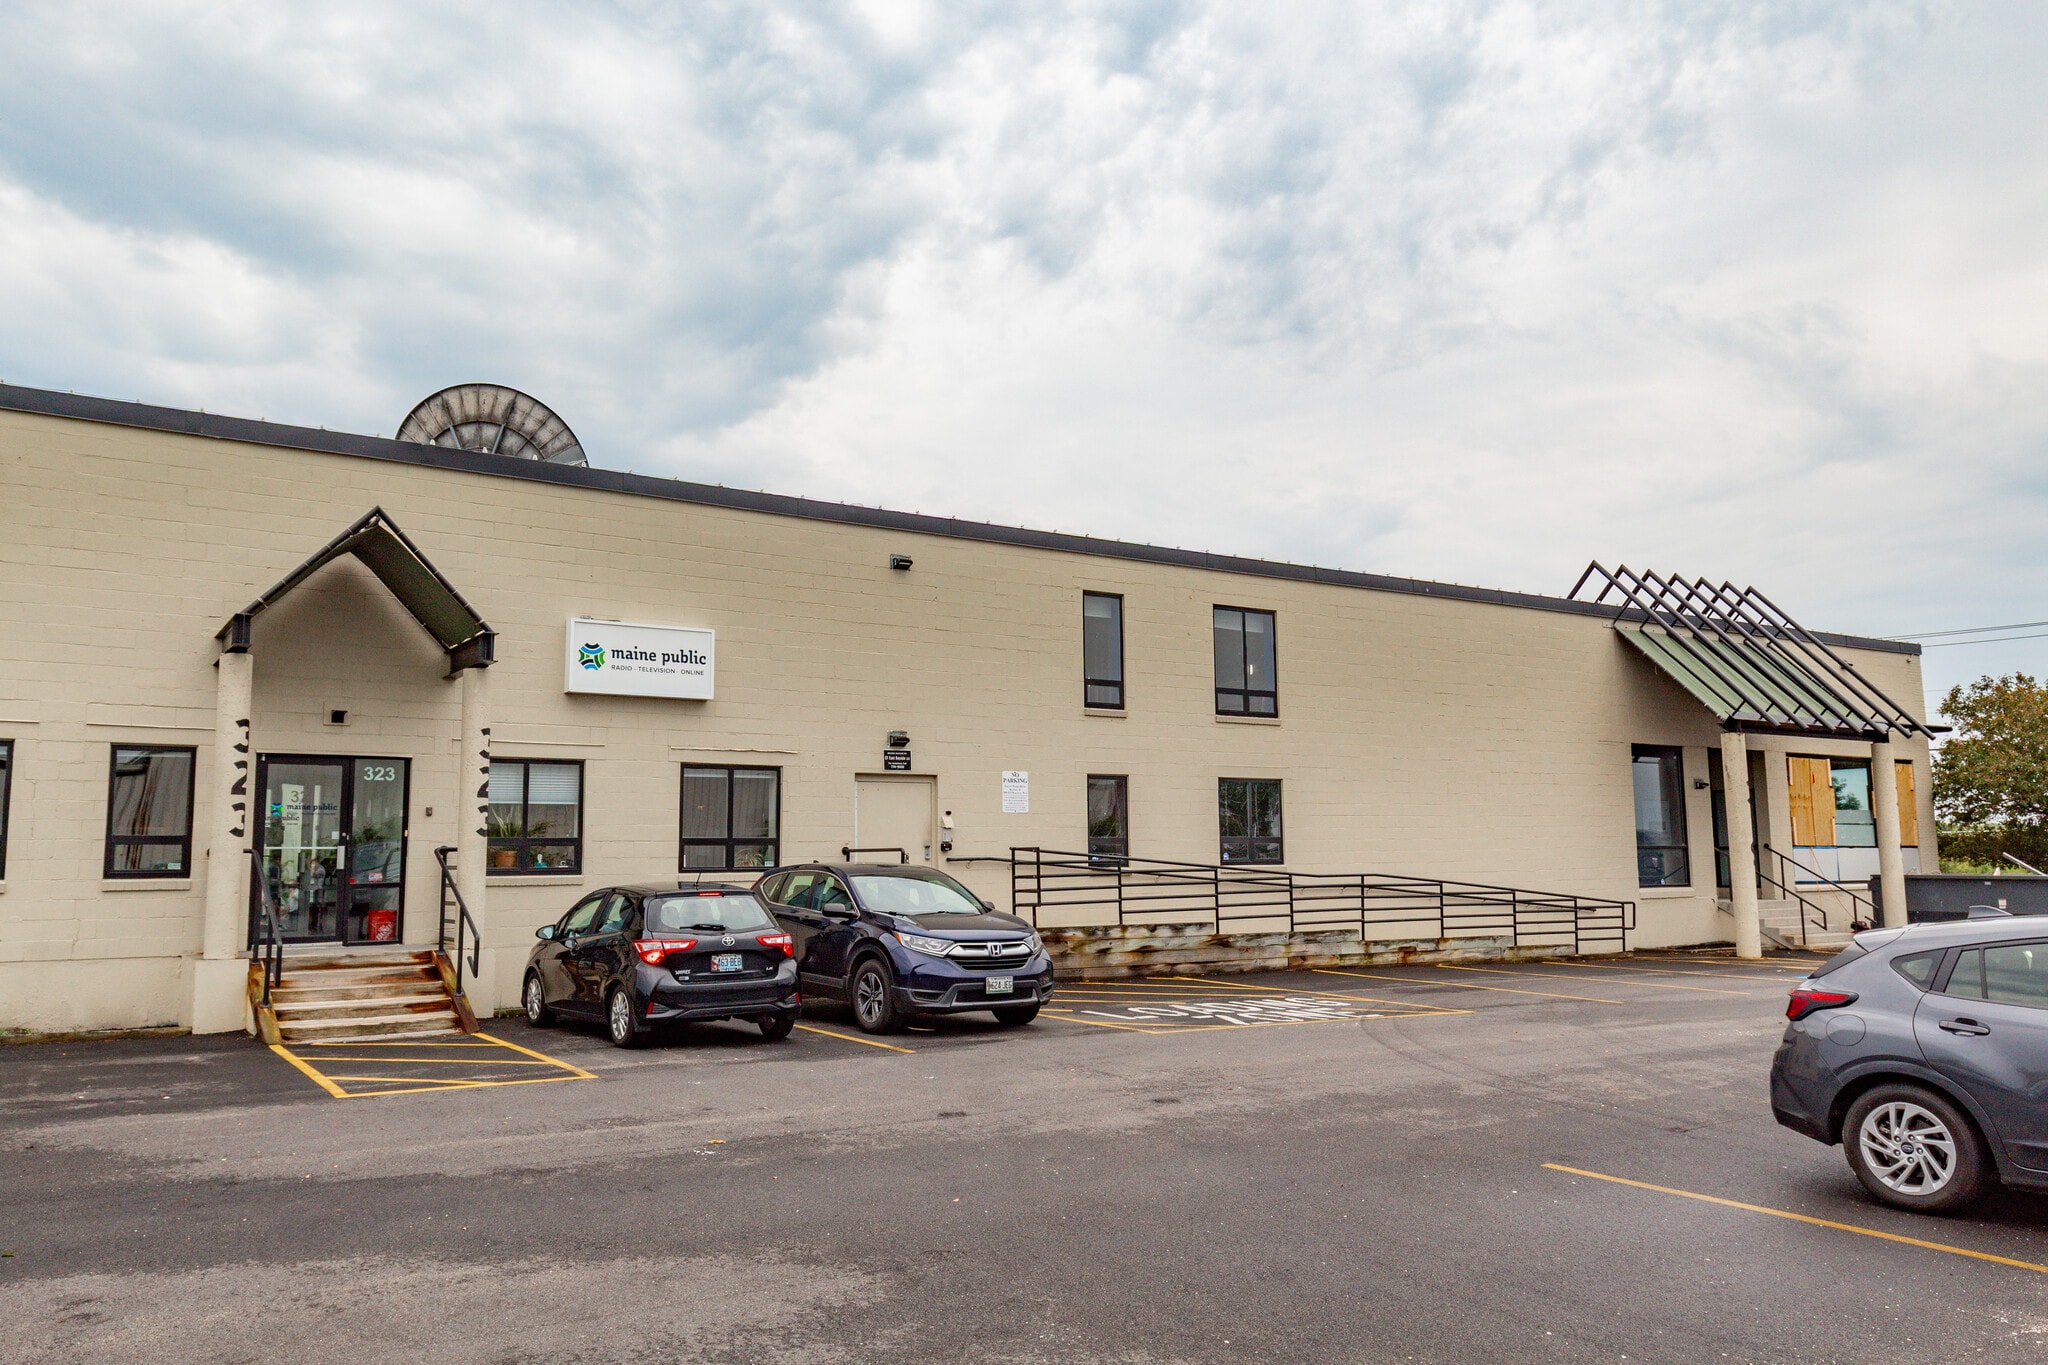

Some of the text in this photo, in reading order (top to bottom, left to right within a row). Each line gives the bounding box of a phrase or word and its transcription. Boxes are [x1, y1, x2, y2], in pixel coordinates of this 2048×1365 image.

[611, 646, 707, 666] maine public
[611, 664, 633, 672] RADIO
[638, 666, 676, 674] TELEVISION
[363, 766, 396, 781] 323
[286, 802, 337, 813] maine public
[1080, 997, 1352, 1020] LOADING
[1191, 1008, 1385, 1026] ZONE
